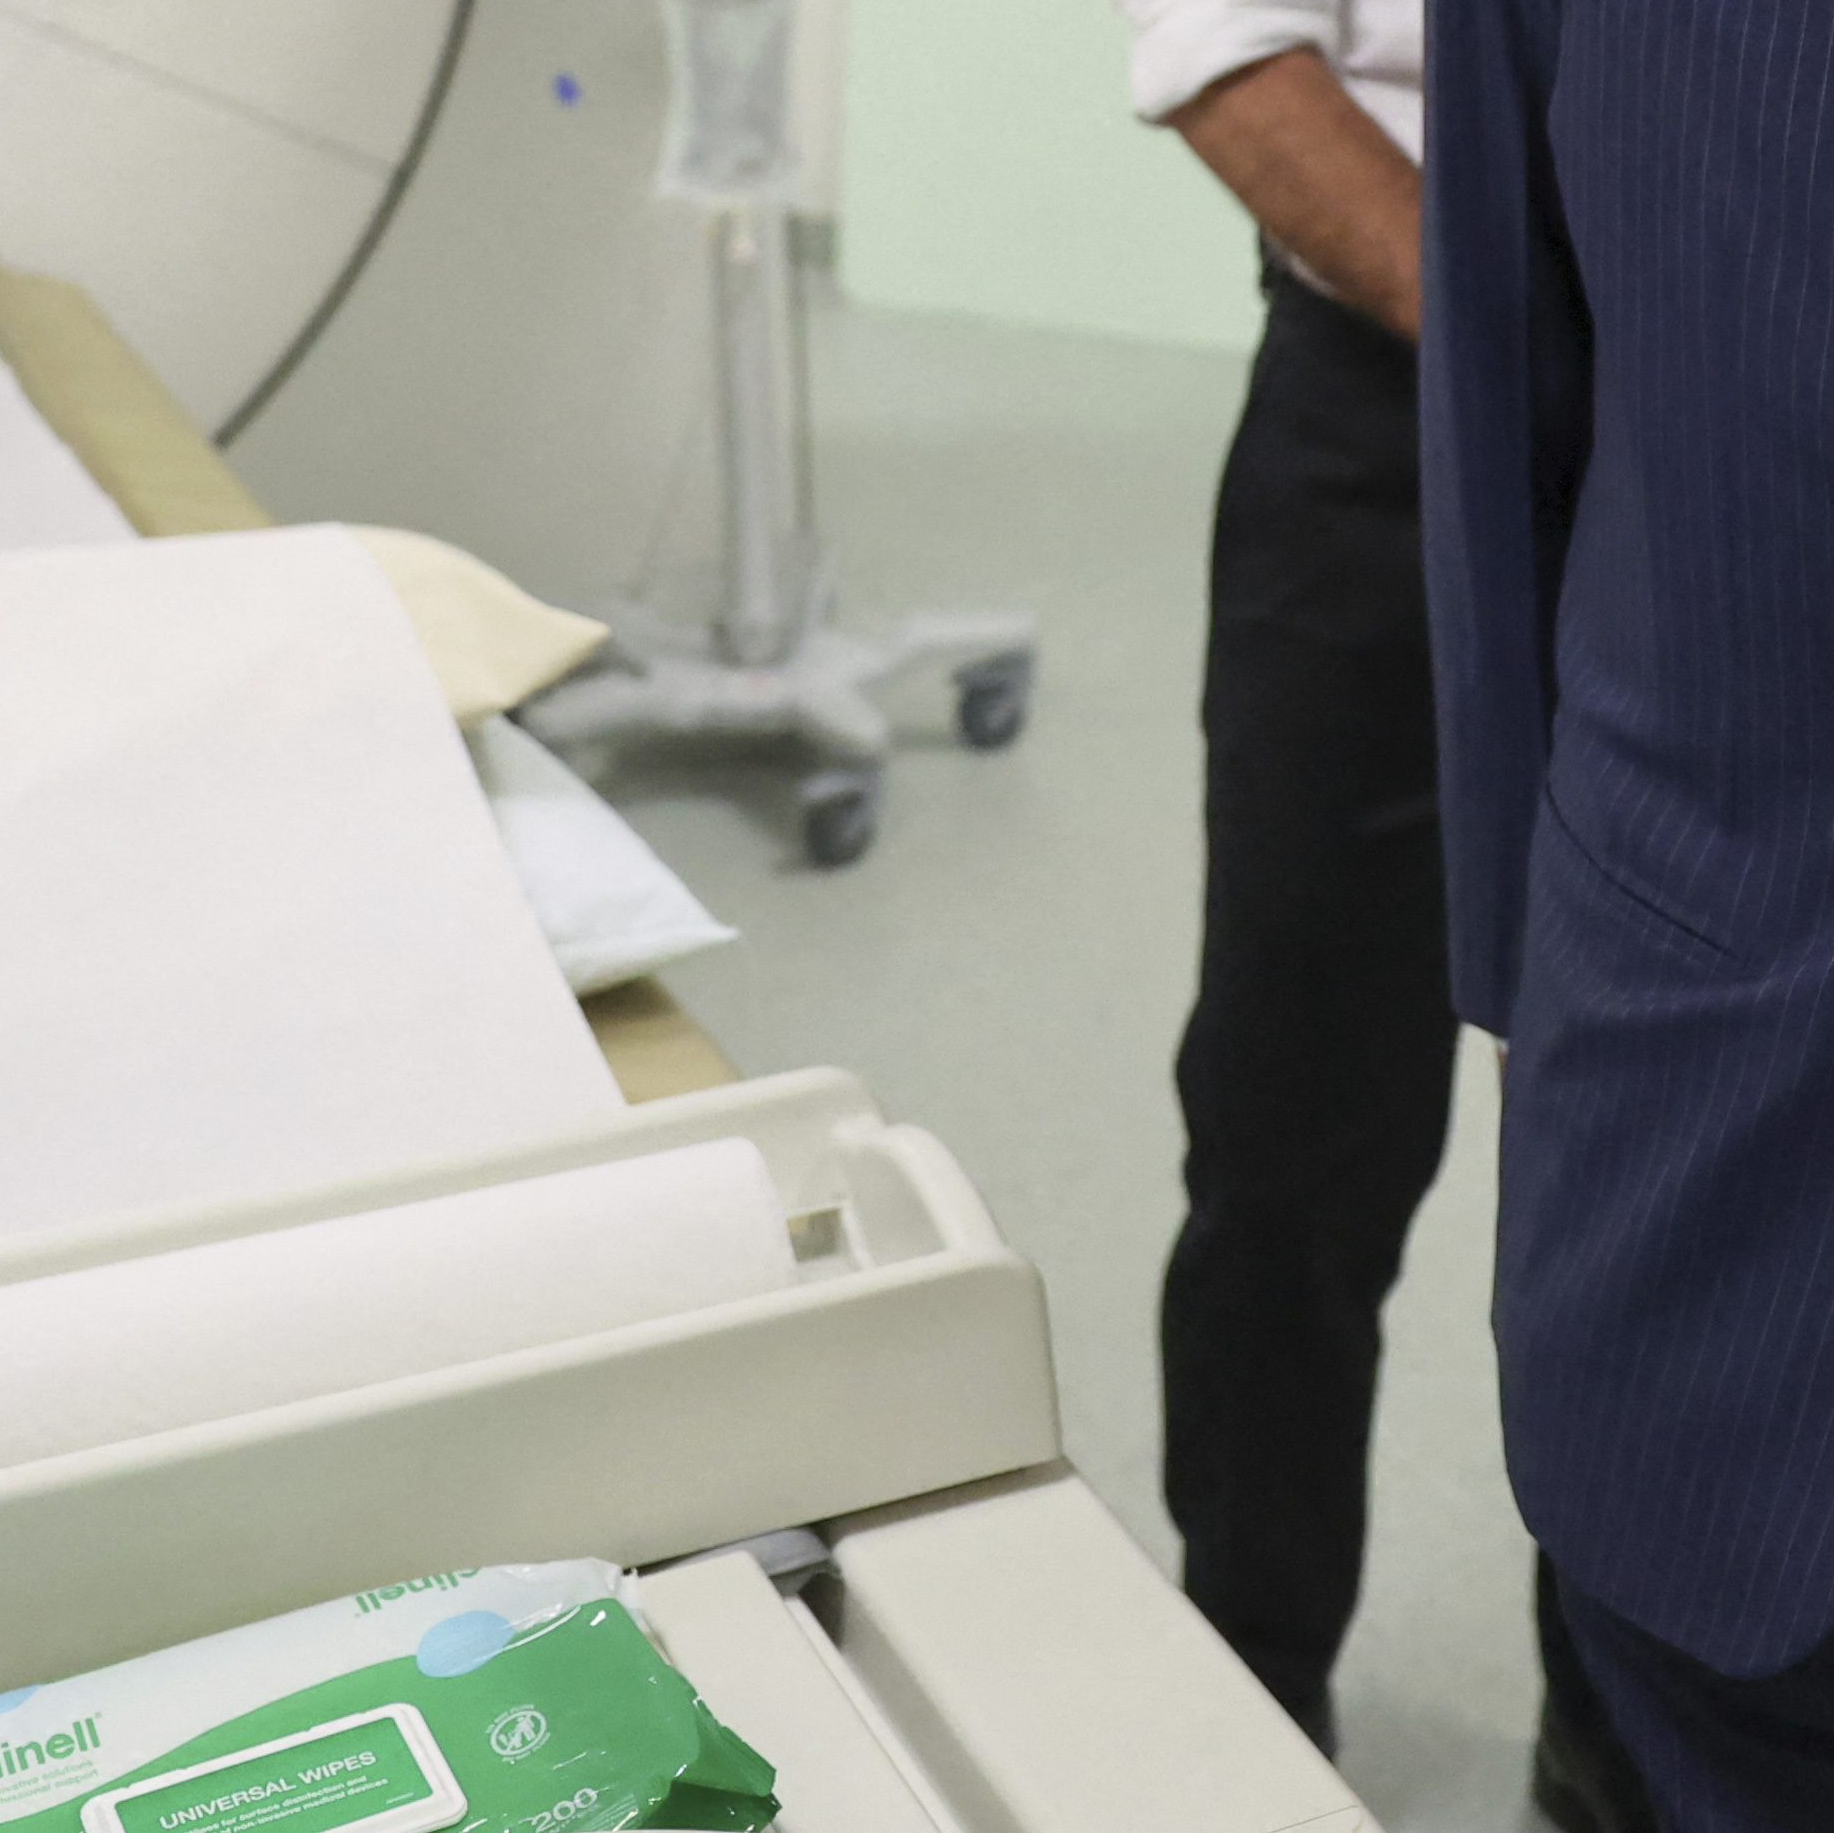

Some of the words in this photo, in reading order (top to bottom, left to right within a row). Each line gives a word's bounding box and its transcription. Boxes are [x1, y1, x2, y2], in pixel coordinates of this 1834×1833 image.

[159, 1778, 297, 1830] UNIVERSAL
[297, 1750, 377, 1785] WIPES
[303, 1791, 346, 1810] medical
[347, 1778, 389, 1796] devices
[346, 1774, 367, 1787] and
[531, 1787, 598, 1833] 200
